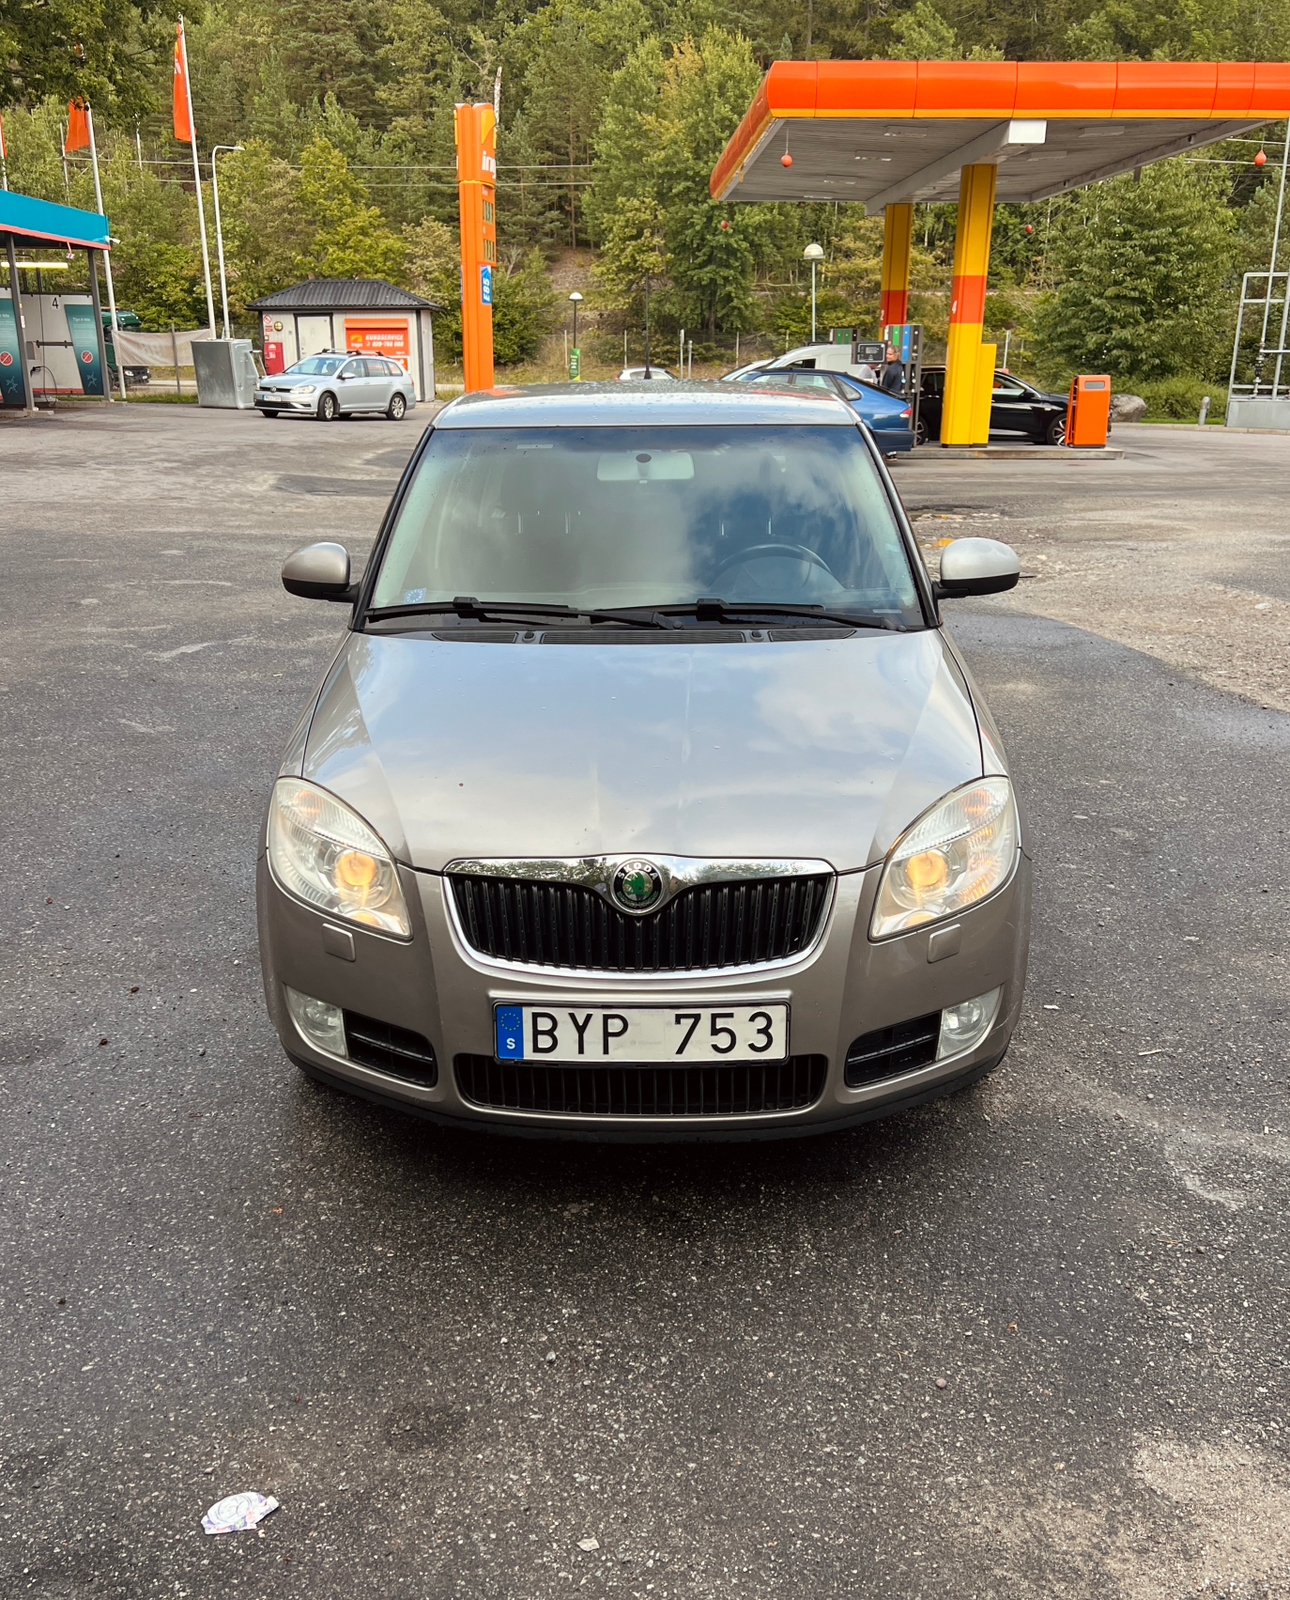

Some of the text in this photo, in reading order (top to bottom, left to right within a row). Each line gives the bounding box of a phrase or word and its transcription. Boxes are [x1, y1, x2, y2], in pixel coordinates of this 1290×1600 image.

[482, 277, 491, 302] E85
[52, 297, 59, 309] 4
[365, 333, 404, 341] KUNDSERVICE
[531, 1011, 774, 1055] BYP 753
[506, 1037, 516, 1050] S
